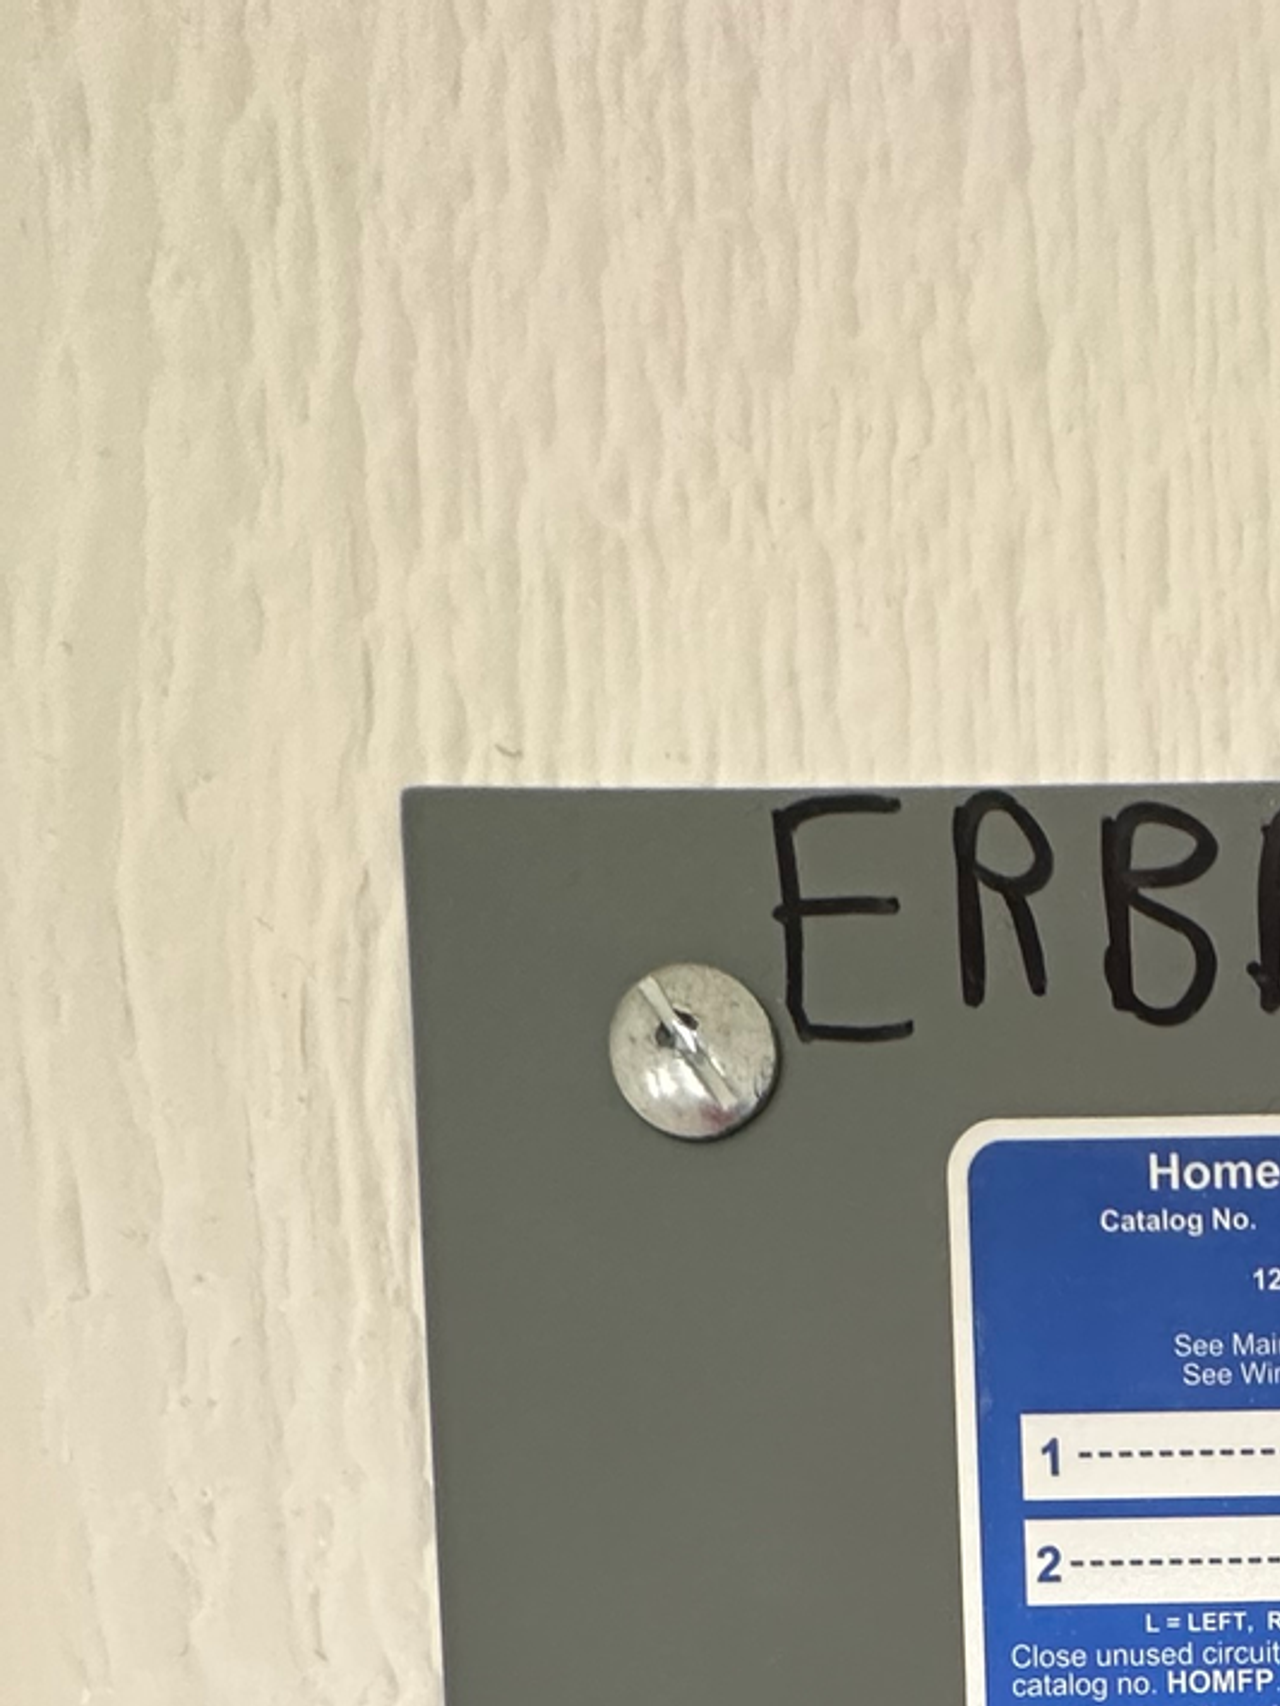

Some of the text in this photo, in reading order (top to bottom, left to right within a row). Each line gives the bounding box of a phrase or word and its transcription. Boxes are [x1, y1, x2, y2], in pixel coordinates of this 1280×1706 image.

[1100, 1208, 1204, 1237] Catalog
[1212, 1207, 1256, 1231] No.
[1041, 1438, 1060, 1476] 1
[1037, 1546, 1062, 1583] 2
[1011, 1643, 1087, 1669] Close
[1096, 1641, 1194, 1669] unused
[1012, 1672, 1108, 1702] catalog
[1117, 1676, 1157, 1696] no.
